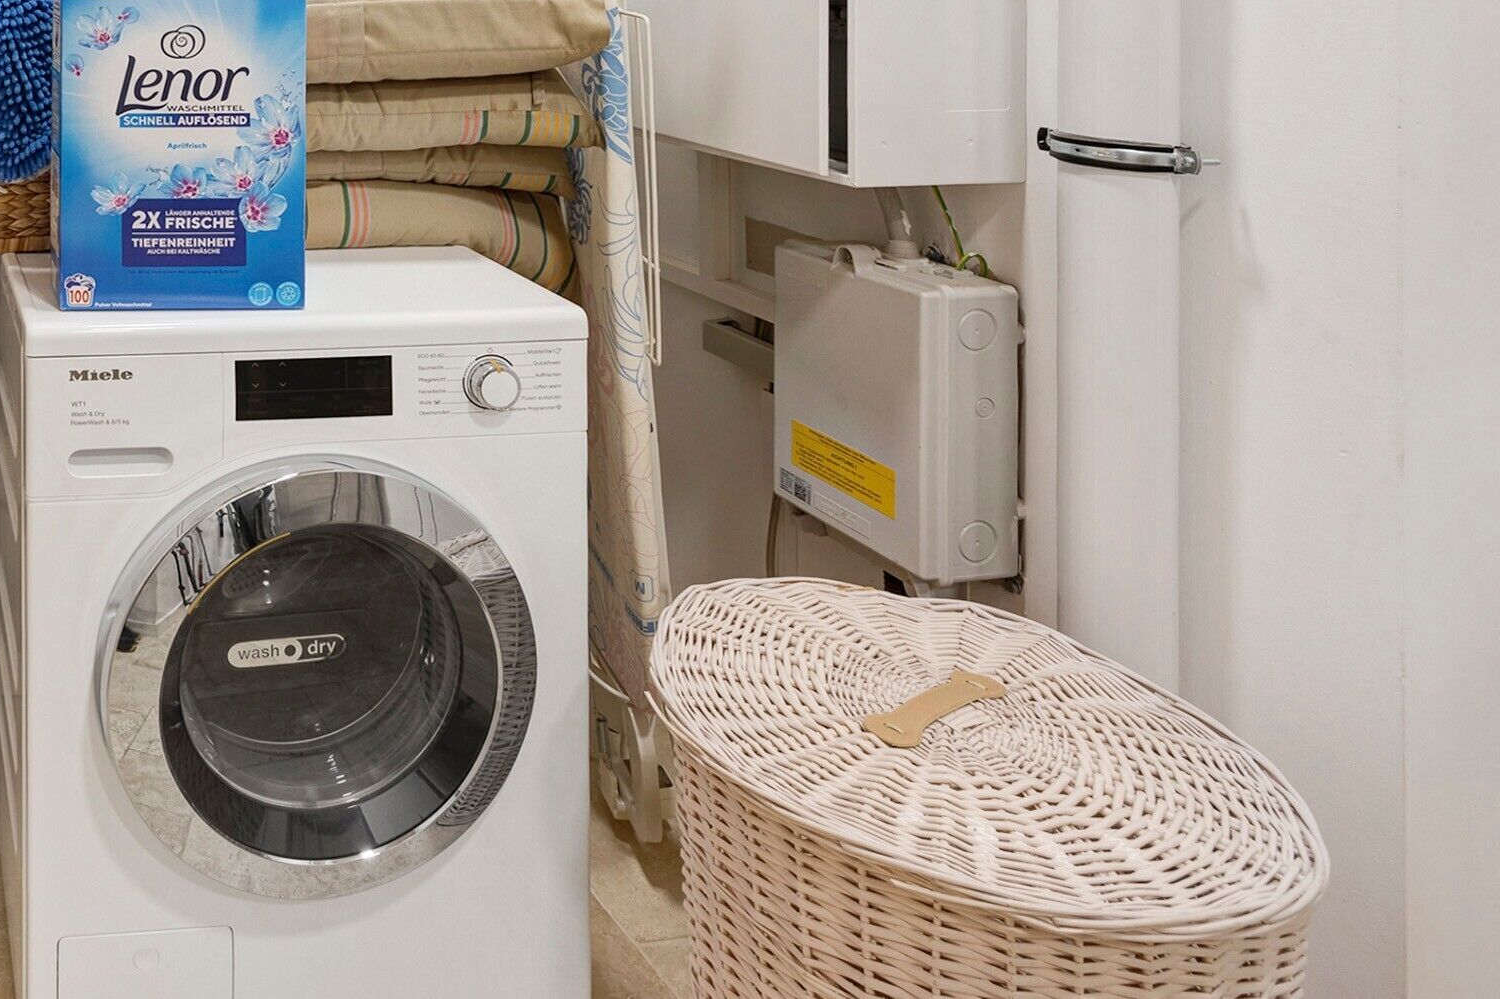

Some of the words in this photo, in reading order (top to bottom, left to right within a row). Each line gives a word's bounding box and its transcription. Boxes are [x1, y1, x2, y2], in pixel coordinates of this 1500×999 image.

[115, 55, 250, 116] Lenor
[123, 117, 176, 126] SCHNELL
[178, 113, 248, 126] AUFLÖSEND
[166, 142, 207, 150] Aprilfrisch
[165, 208, 192, 216] LÄNGER
[131, 210, 162, 229] 2X
[131, 237, 236, 247] TIEFENREINHEIT
[178, 247, 221, 255] KALTWÄSCHE
[69, 290, 90, 303] 100
[68, 369, 134, 381] Miele
[237, 644, 280, 661] wash
[307, 639, 337, 657] dry
